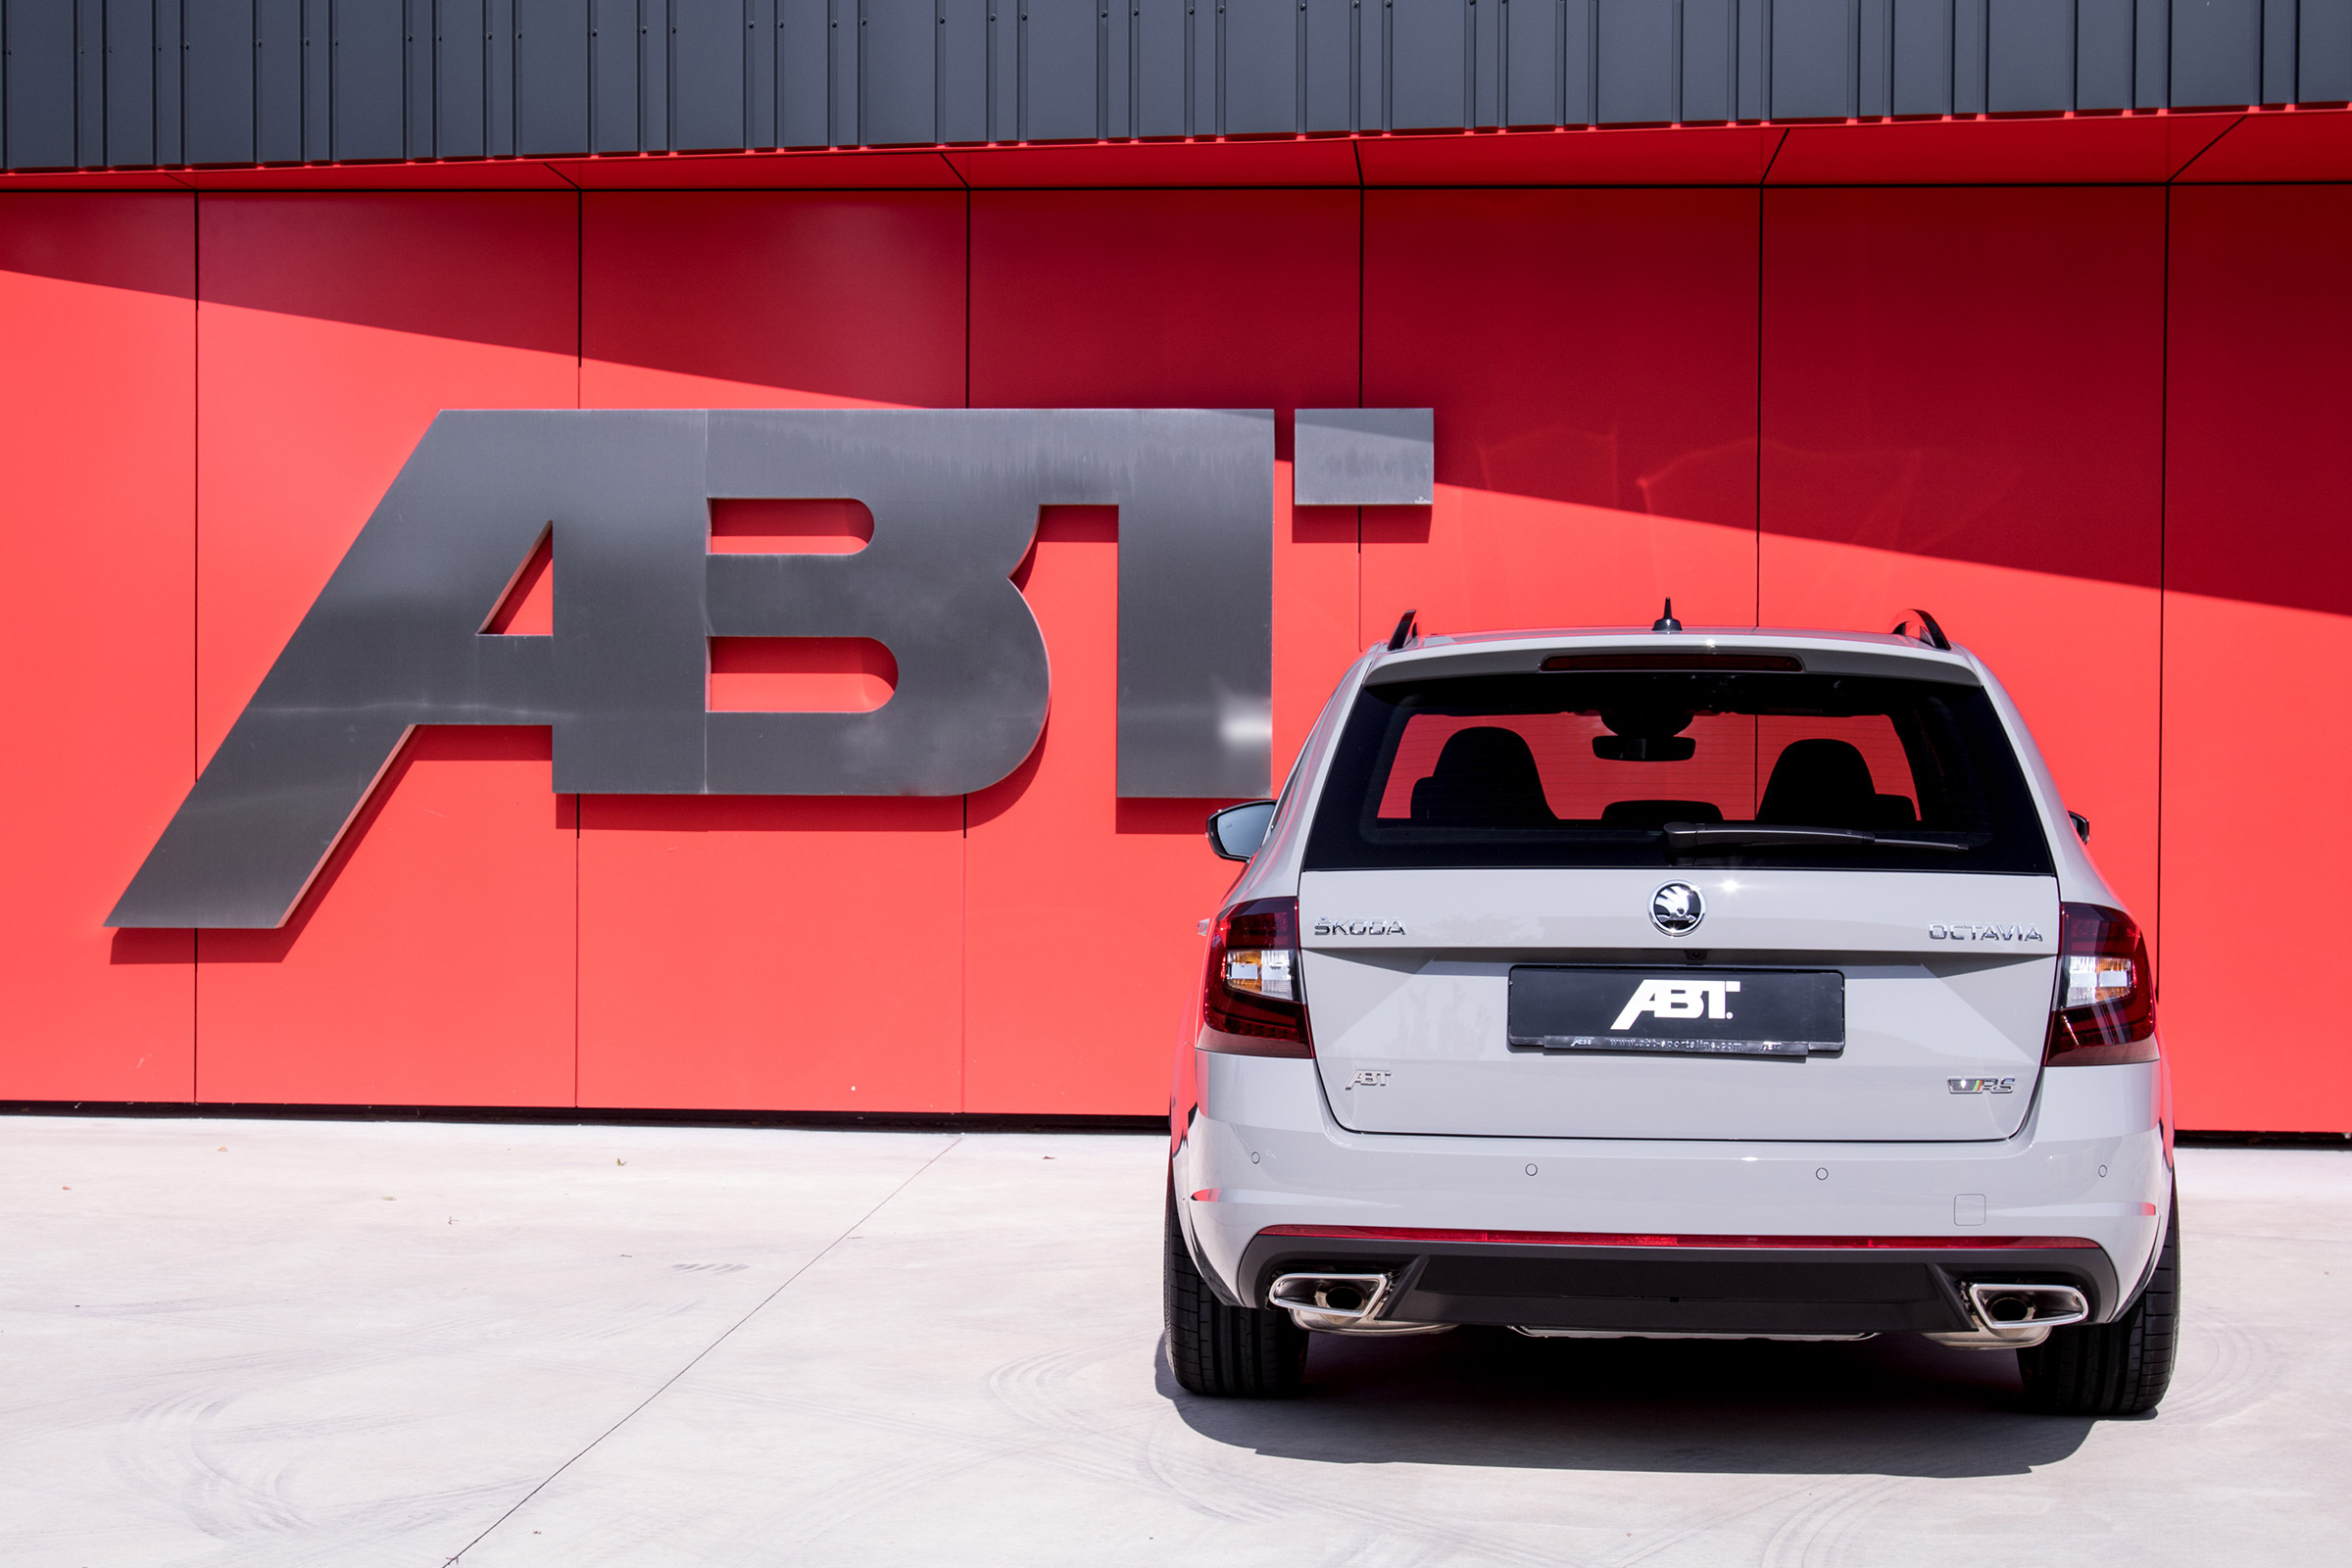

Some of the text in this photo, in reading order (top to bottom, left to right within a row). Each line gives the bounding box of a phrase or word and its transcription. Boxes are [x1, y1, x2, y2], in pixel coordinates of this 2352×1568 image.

[104, 407, 1435, 929] ABT
[1314, 916, 1406, 936] ŠKODA
[1928, 922, 2043, 942] OCTAVIA
[1345, 1069, 1391, 1091] ABT
